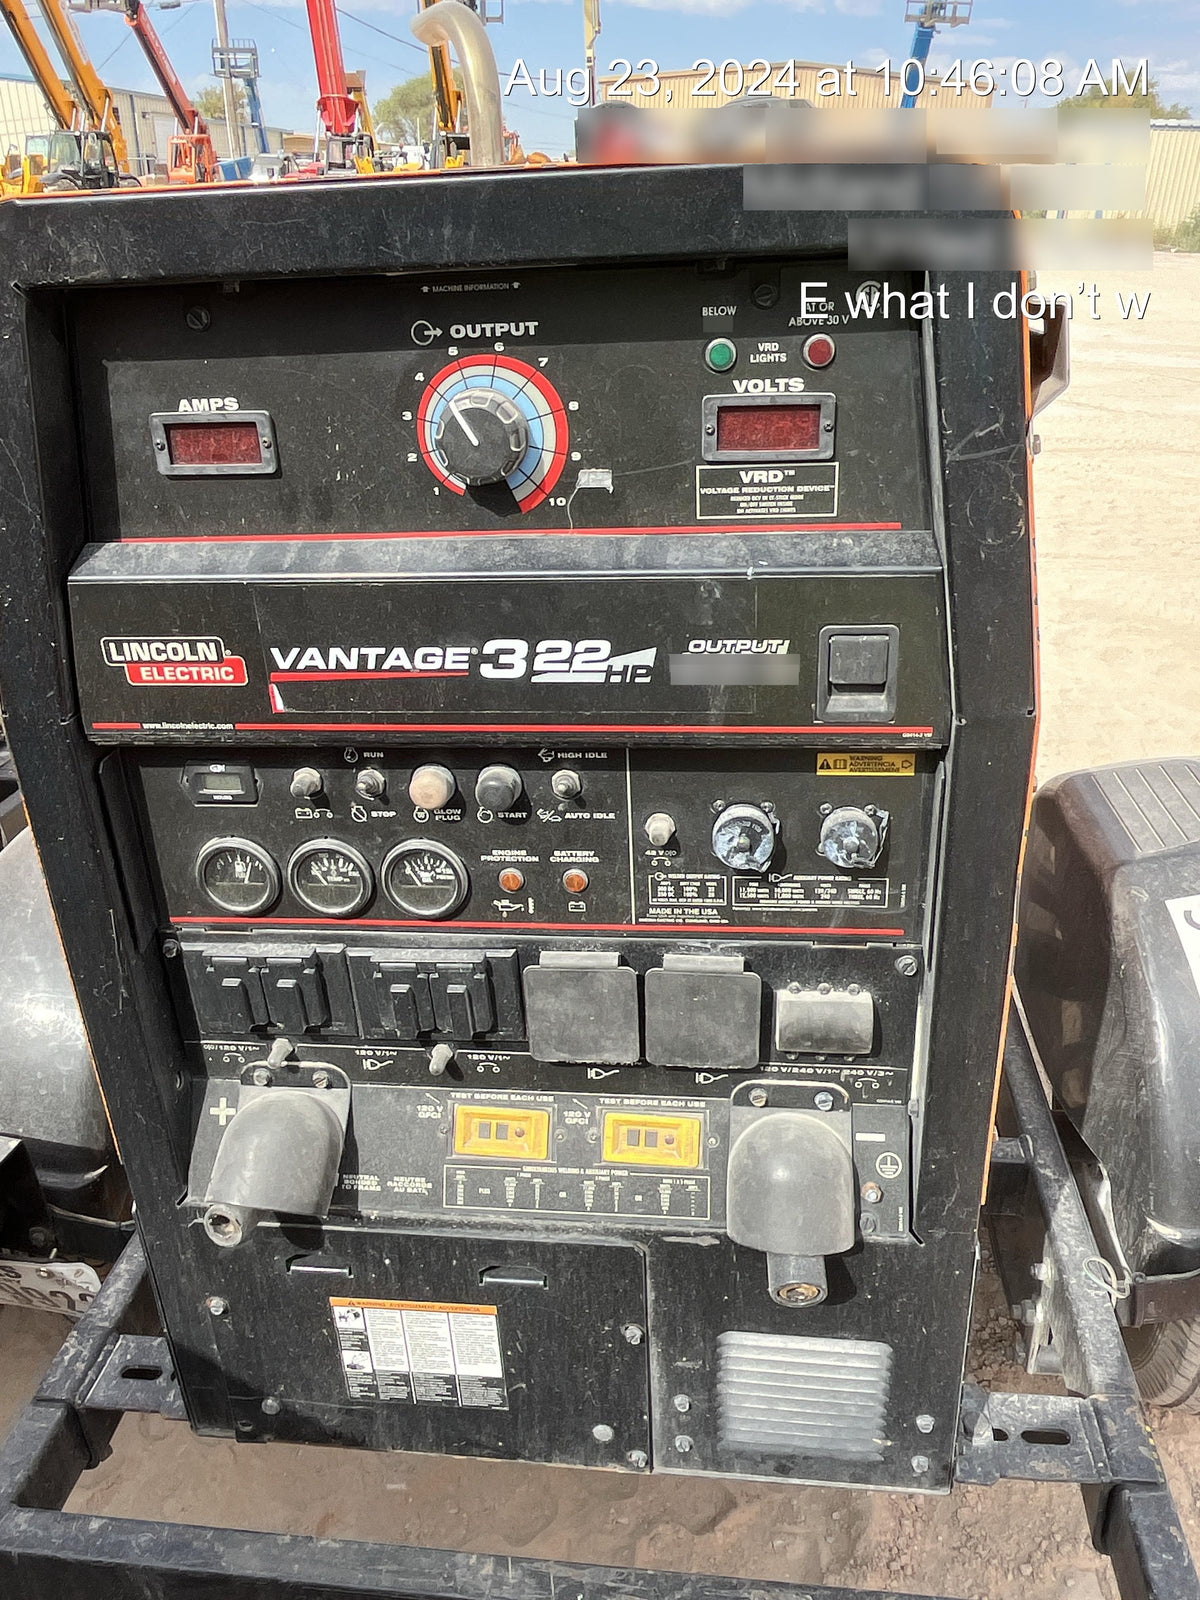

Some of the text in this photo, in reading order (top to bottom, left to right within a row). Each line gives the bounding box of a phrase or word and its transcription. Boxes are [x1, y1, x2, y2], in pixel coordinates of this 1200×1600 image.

[432, 282, 510, 293] MACHINE INFORMATION
[702, 306, 737, 317] BELOW
[818, 302, 835, 311] OR
[788, 314, 850, 327] ABOVE 30 V
[450, 321, 539, 339] OUTPUT
[448, 346, 458, 356] 5
[494, 342, 504, 352] 6
[757, 342, 779, 352] VRD
[538, 357, 549, 367] 7
[750, 353, 787, 363] LIGHTS
[414, 372, 425, 382] 4
[733, 377, 805, 393] VOLTS
[178, 397, 240, 412] AMPS
[568, 401, 579, 411] 8
[402, 411, 412, 420] 3
[407, 453, 418, 462] 2
[570, 452, 581, 461] 9
[433, 487, 440, 496] 1
[741, 486, 794, 494] REDUCTION
[549, 497, 567, 507] 10
[688, 639, 784, 653] OUTPUT
[109, 642, 218, 662] LINCOLN
[479, 638, 613, 679] 322
[140, 666, 235, 682] ELECTRIC
[142, 722, 234, 731] www.lincolnelectric.com
[599, 1097, 621, 1105] TEST
[623, 1098, 659, 1106] BEFORE
[416, 1104, 434, 1112] 120
[563, 1110, 582, 1118] 120
